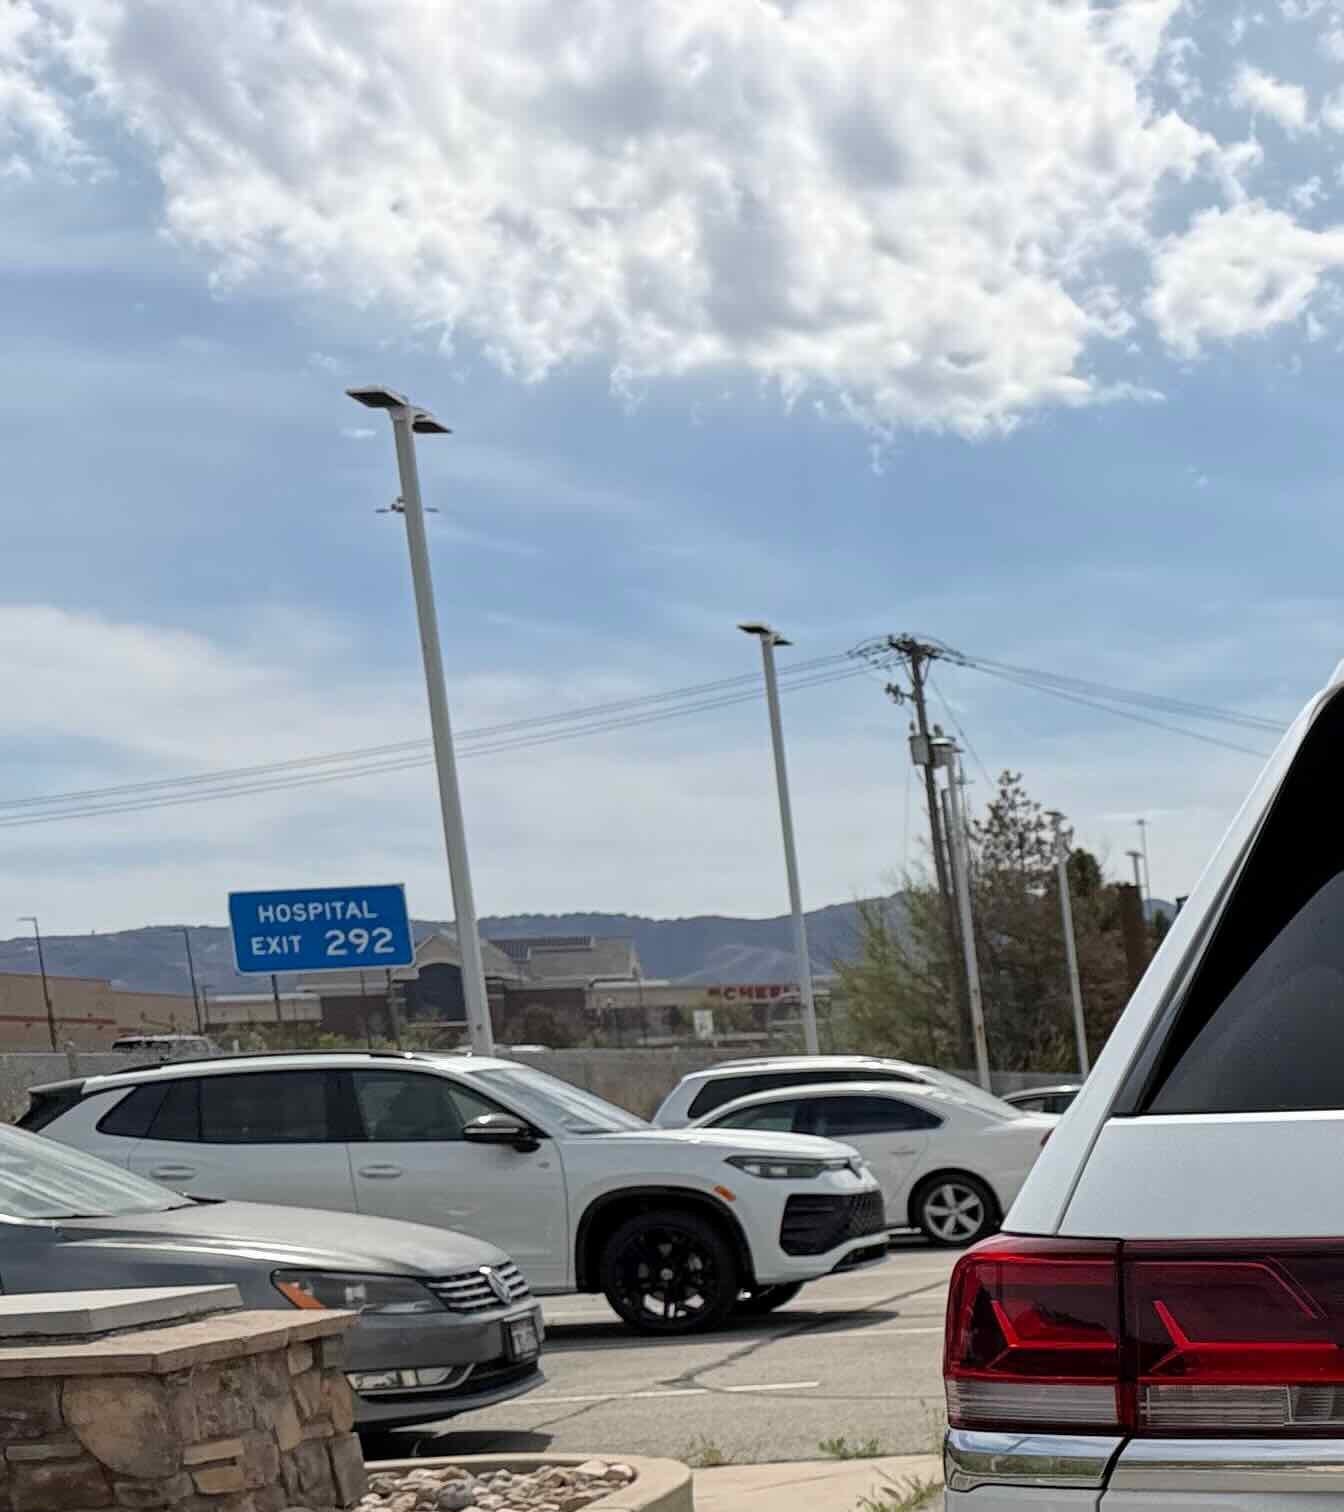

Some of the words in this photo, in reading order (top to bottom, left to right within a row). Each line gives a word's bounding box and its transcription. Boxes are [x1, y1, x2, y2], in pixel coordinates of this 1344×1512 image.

[257, 900, 378, 923] HOSPITAL
[251, 935, 302, 956] EXIT
[324, 927, 395, 956] 292
